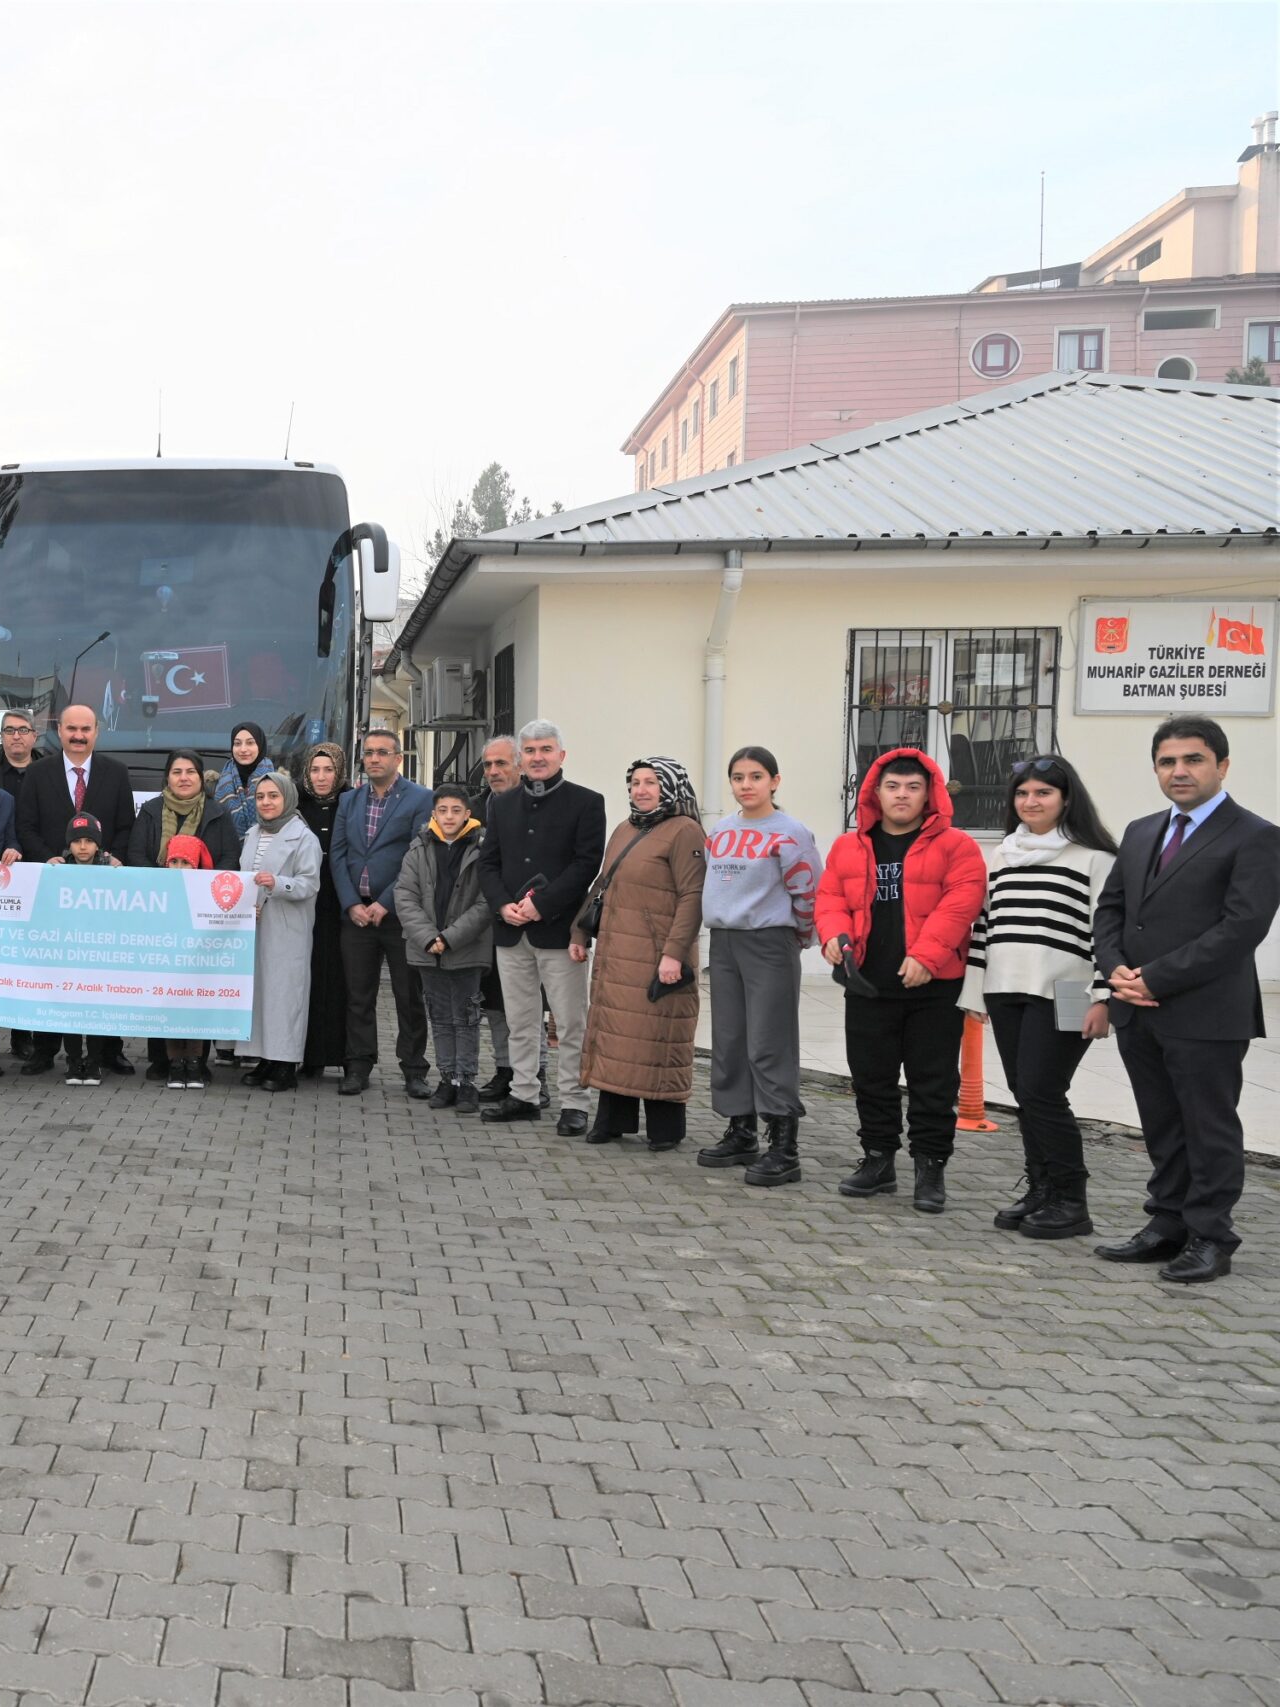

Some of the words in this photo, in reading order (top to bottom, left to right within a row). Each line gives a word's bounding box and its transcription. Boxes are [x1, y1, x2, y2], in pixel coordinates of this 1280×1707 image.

[1148, 644, 1205, 660] TÜRKİYE
[1087, 662, 1145, 678] MUHARİP
[1149, 662, 1204, 678] GAZİLER
[1208, 662, 1266, 678] DERNEĞİ
[1122, 684, 1176, 697] BATMAN
[1179, 681, 1227, 700] ŞUBESİ
[59, 886, 168, 913] BATMAN
[8, 928, 25, 940] VE
[28, 928, 60, 943] GAZİ
[64, 928, 117, 945] AİLELERİ
[120, 931, 178, 948] DERNEĞİ
[181, 935, 248, 952] (BAŞGAD)
[22, 946, 63, 960] VATAN
[66, 947, 135, 964] DİYENLERE
[139, 952, 170, 966] VEFA
[175, 952, 236, 968] ETKİNLİĞİ
[16, 979, 53, 990] Erzurum
[62, 982, 74, 991] 27
[76, 983, 104, 993] Aralık
[106, 984, 143, 995] Trabzon
[152, 986, 164, 996] 28
[166, 986, 194, 997] Aralık
[196, 988, 216, 998] Rize
[218, 988, 241, 998] 2024
